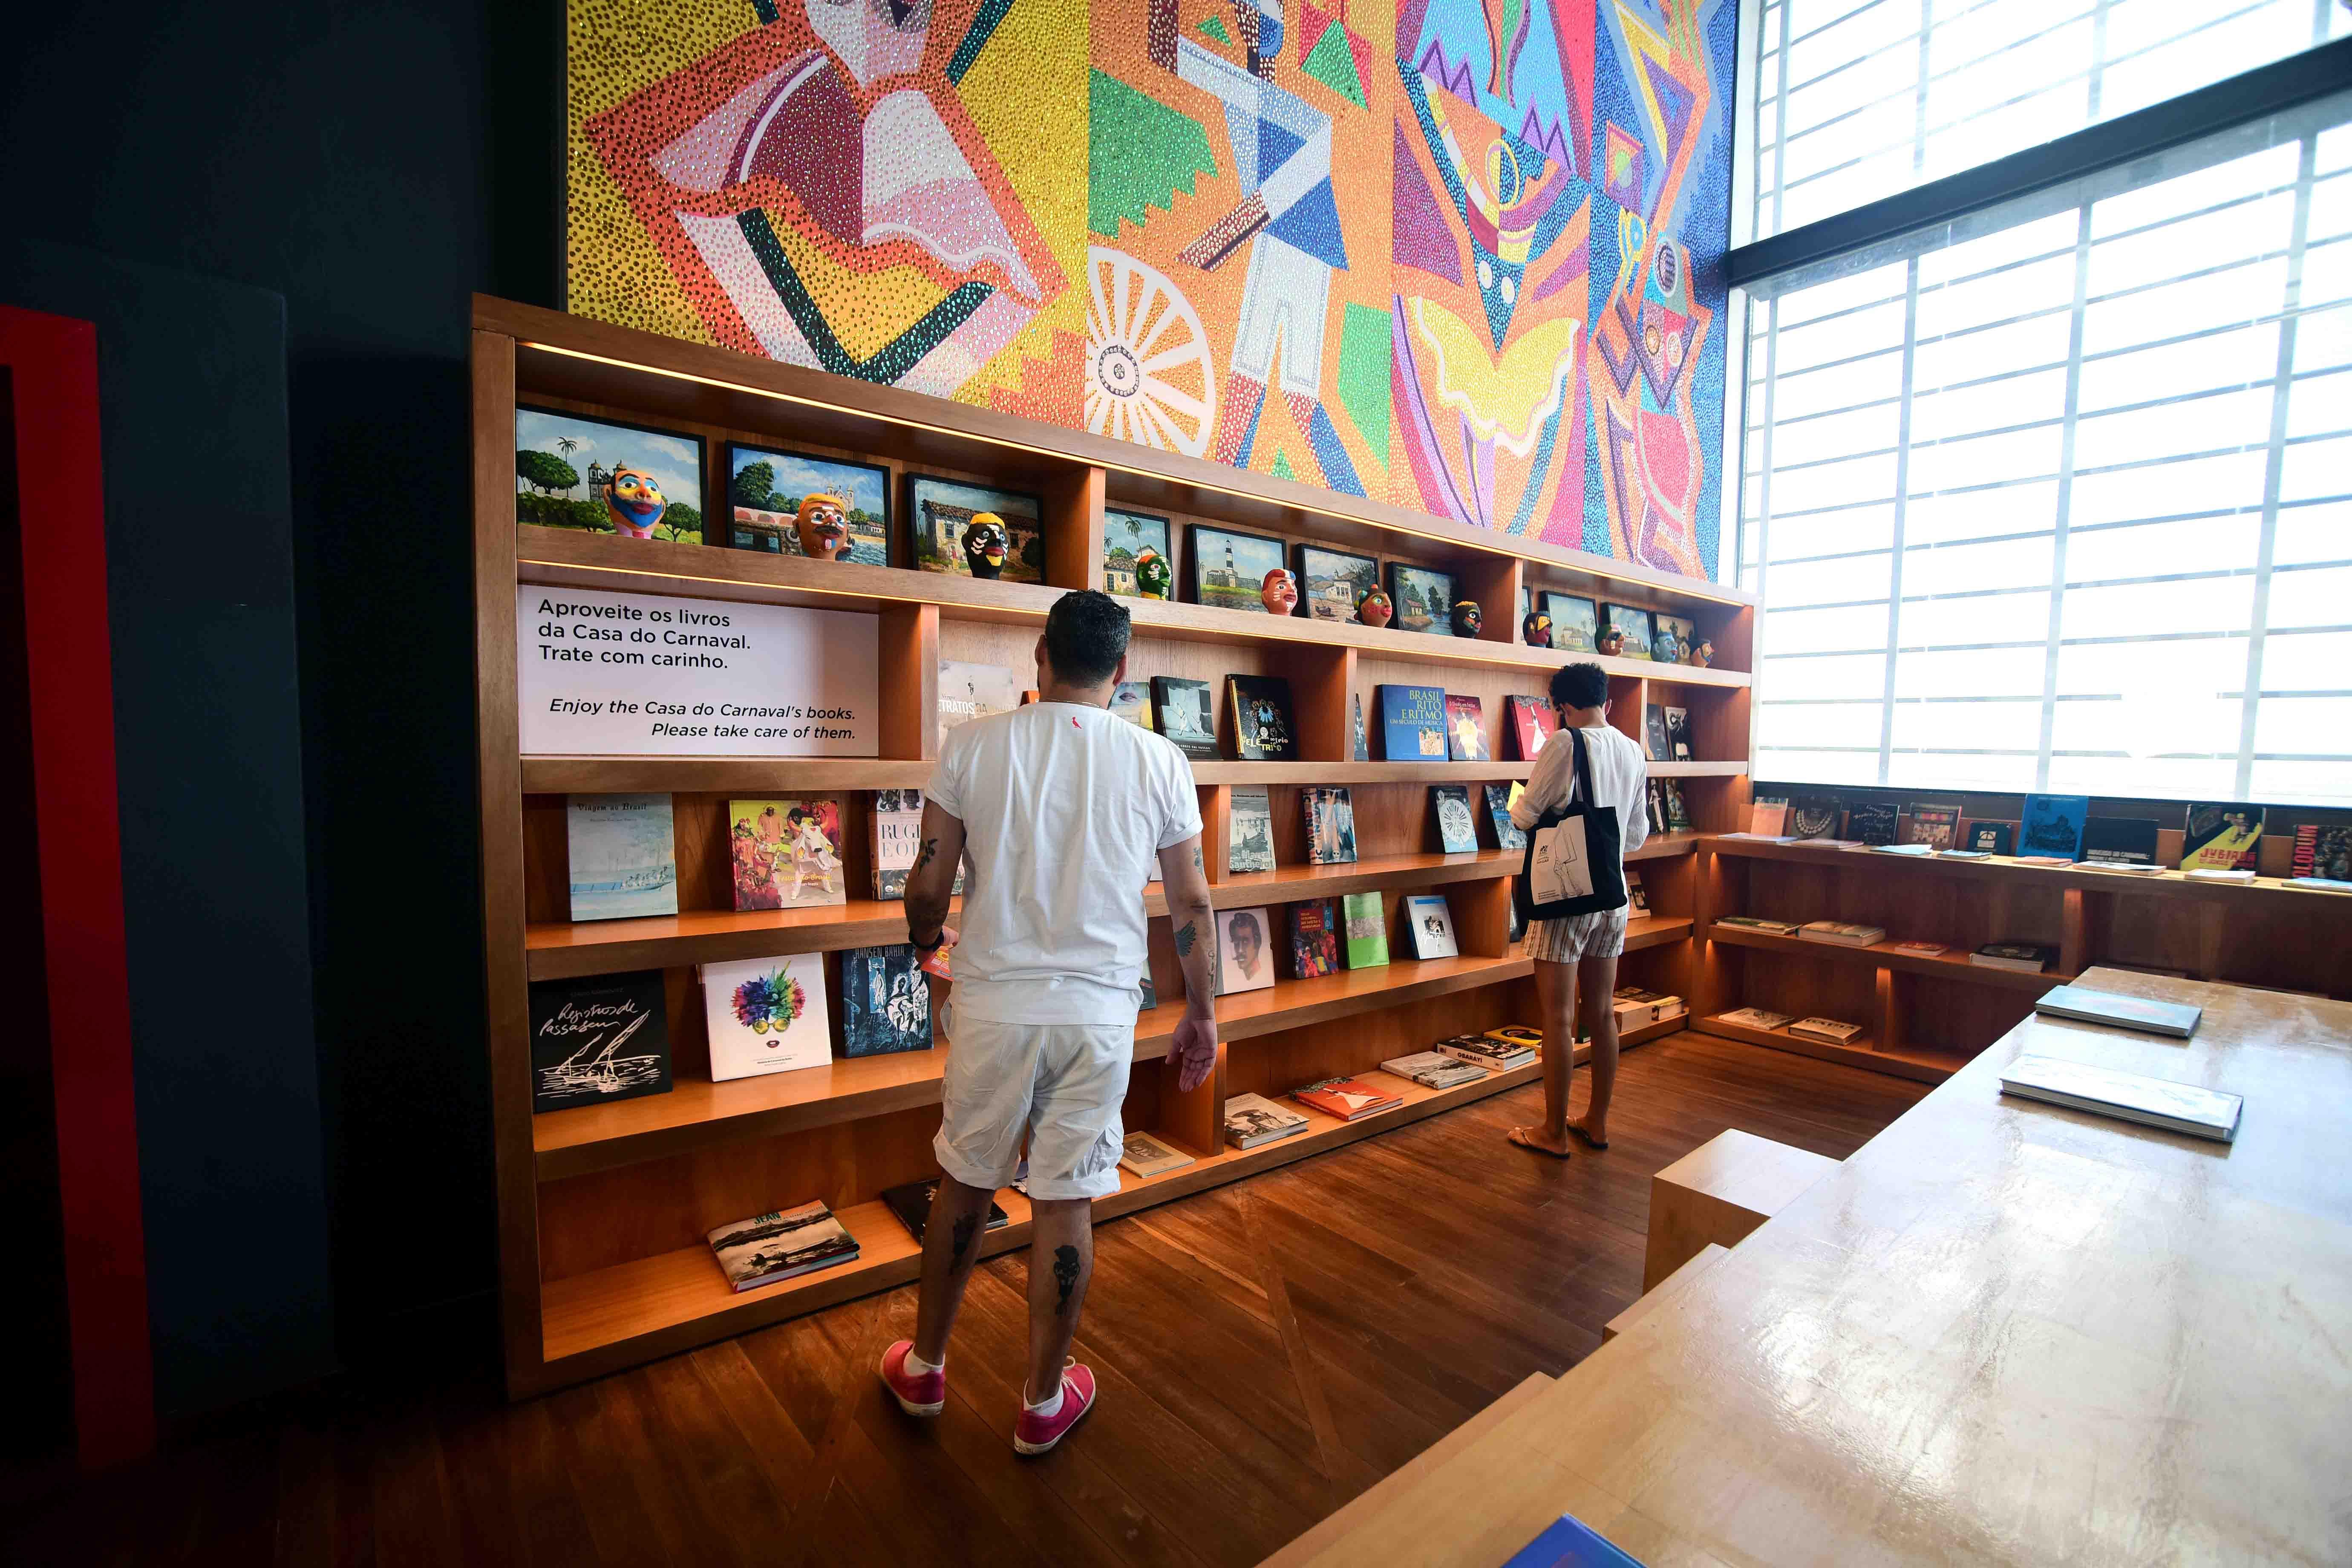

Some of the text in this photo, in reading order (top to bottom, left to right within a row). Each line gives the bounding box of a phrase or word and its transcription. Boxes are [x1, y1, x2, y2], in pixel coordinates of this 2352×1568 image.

[538, 599, 730, 627] Aproveite os livros
[538, 621, 750, 649] da Casa do Carnaval.
[538, 645, 728, 669] Trate com carinho.
[1409, 689, 1442, 701] BRASIL
[550, 698, 855, 720] Enjoy the Casa do Carnaval's books.
[1417, 700, 1442, 710] RITO
[1401, 709, 1442, 720] E RITMO
[651, 723, 855, 739] Please take care of them.
[576, 802, 607, 813] Viagem
[621, 801, 648, 810] Brasil
[855, 945, 905, 959] HANSEN BAHIA
